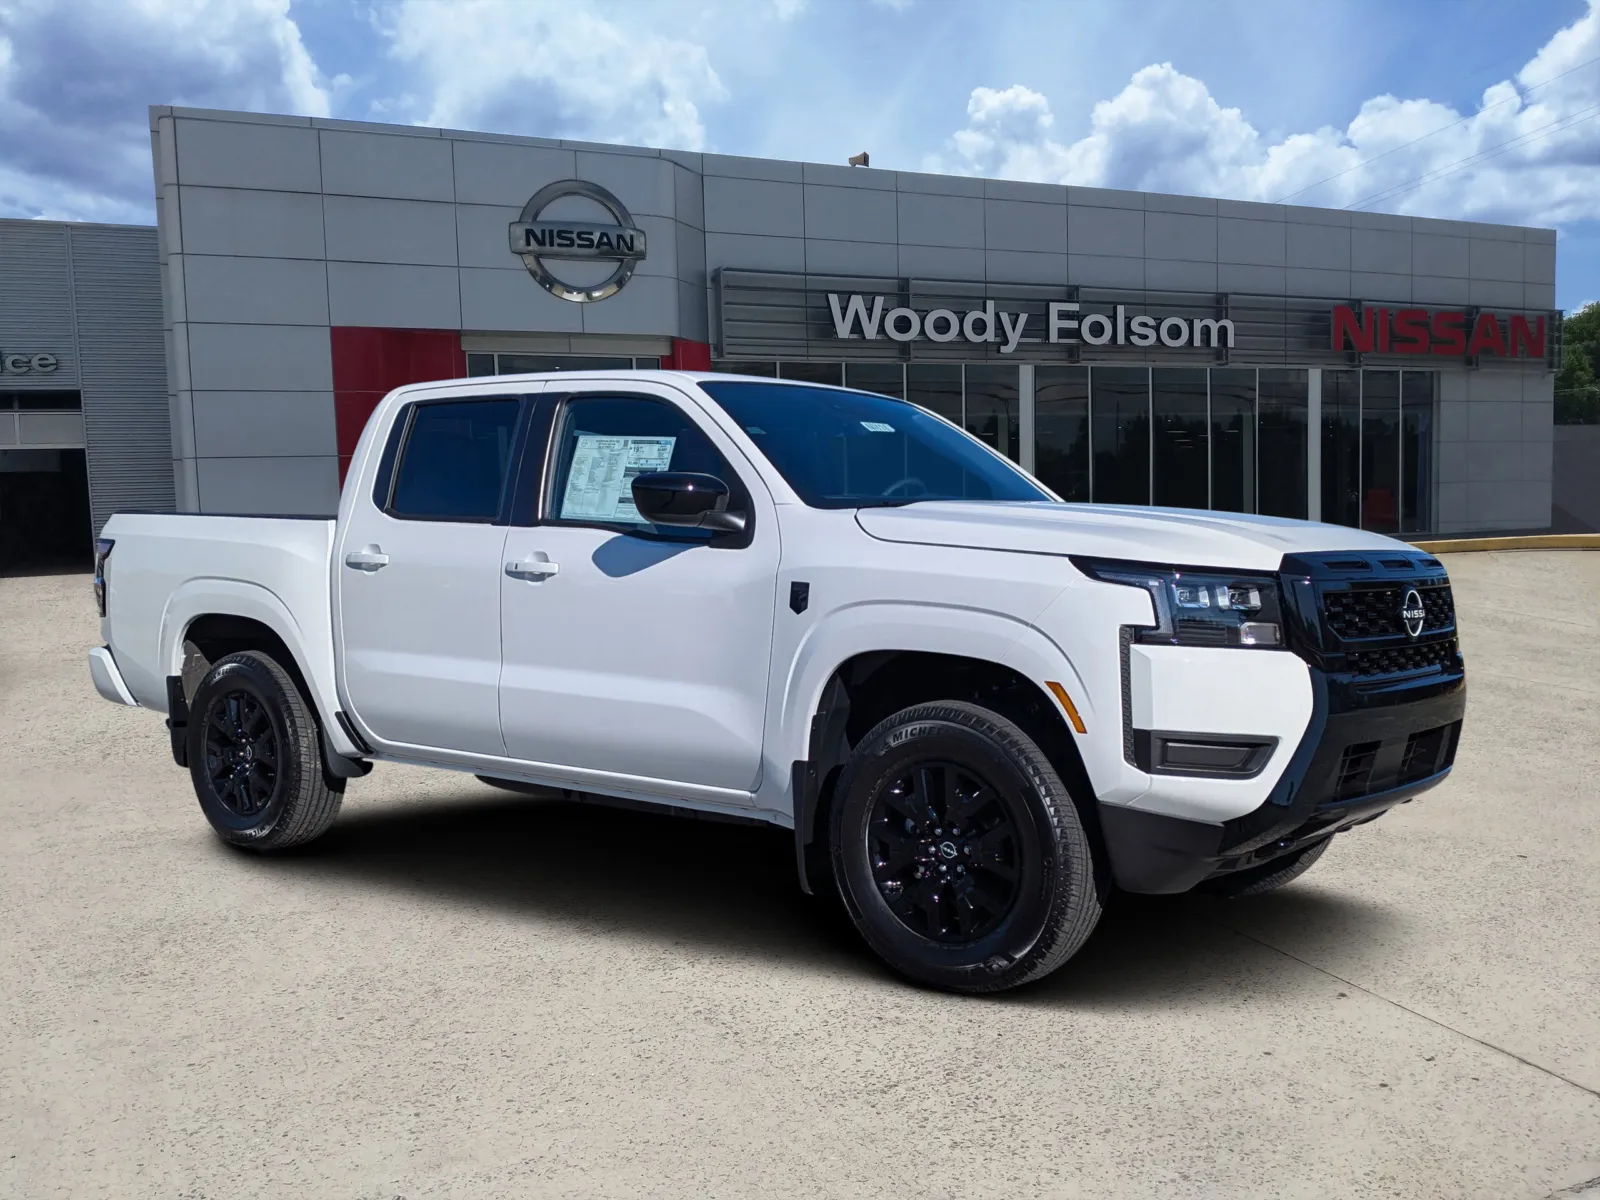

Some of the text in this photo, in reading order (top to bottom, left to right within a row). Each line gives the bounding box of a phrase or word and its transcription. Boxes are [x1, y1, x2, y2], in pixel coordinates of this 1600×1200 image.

[525, 228, 634, 252] NISSAN
[827, 293, 1235, 354] Woody Folsom
[1332, 305, 1545, 358] NISSAN
[0, 353, 57, 373] ce
